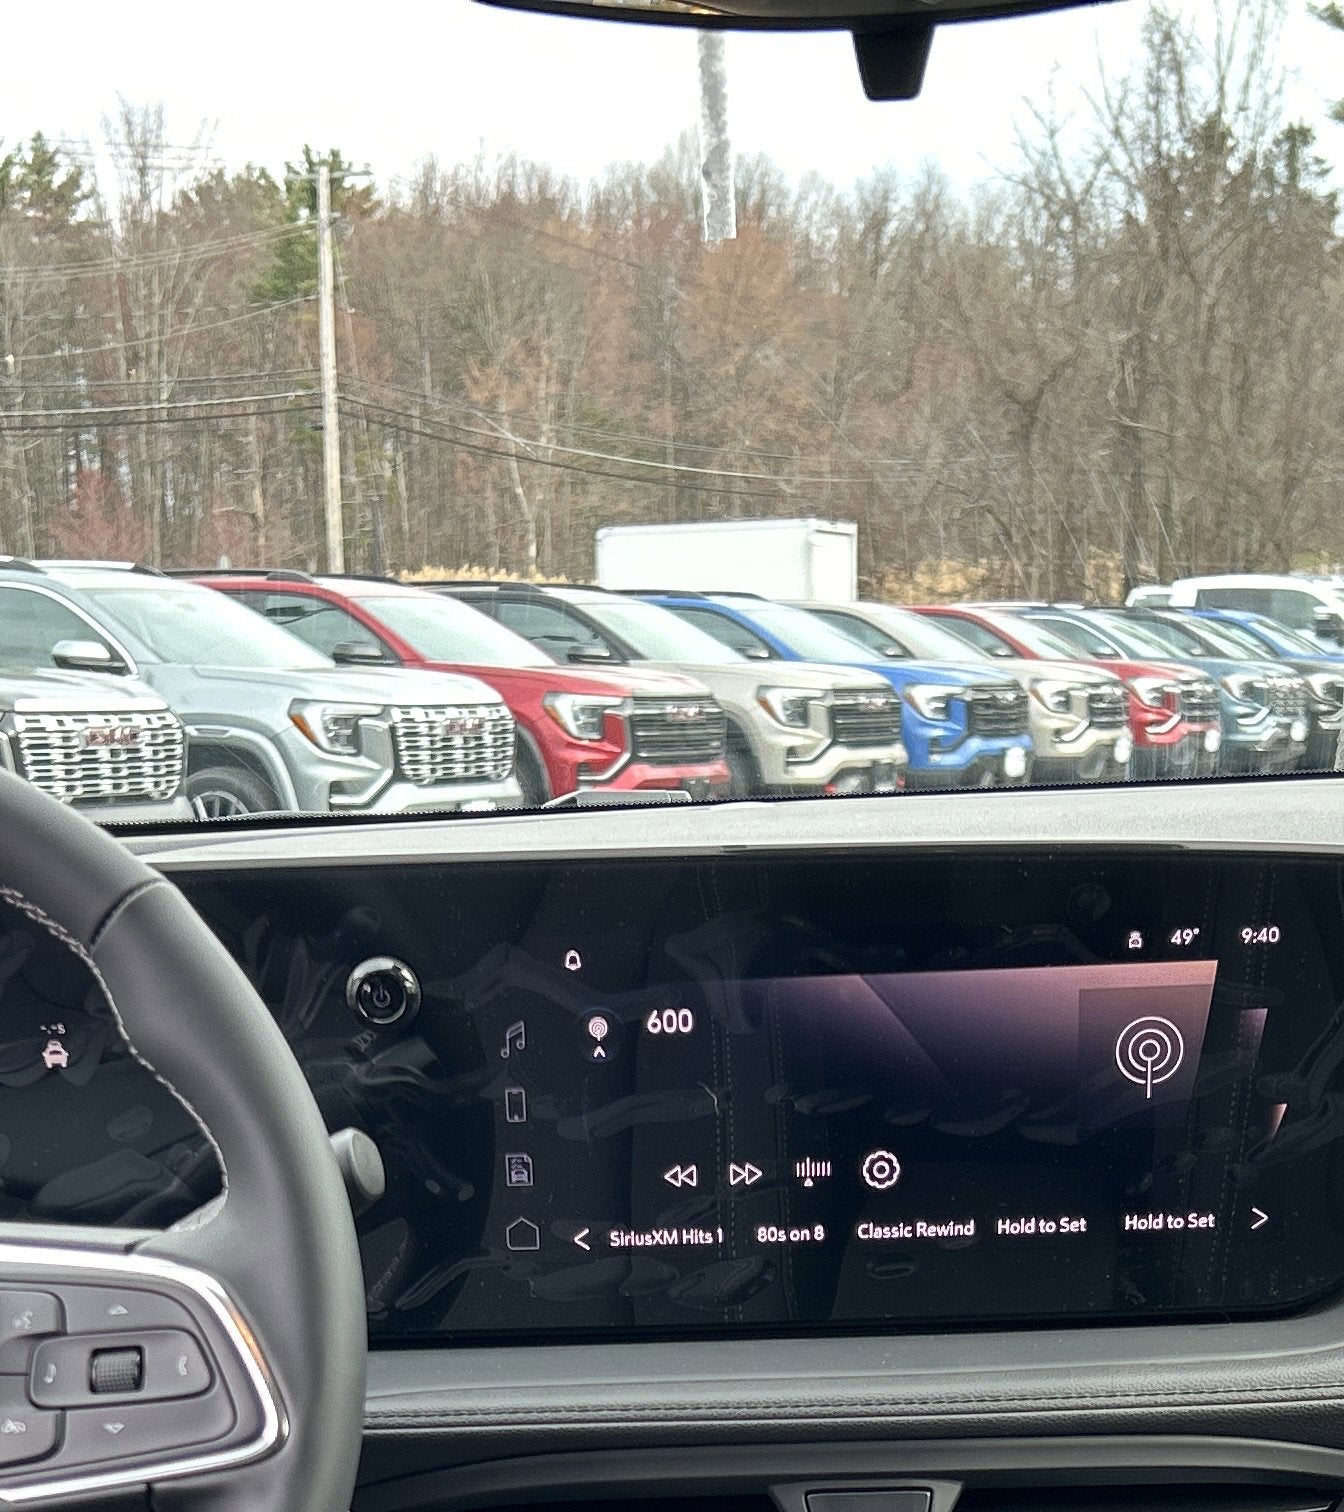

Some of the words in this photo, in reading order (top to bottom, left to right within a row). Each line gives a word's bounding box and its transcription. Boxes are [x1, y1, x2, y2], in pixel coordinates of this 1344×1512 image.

[1241, 926, 1280, 943] 9:40
[647, 1008, 693, 1033] 600
[857, 1220, 913, 1240] Classic
[916, 1219, 974, 1238] Rewind
[997, 1217, 1036, 1235] Hold
[1039, 1219, 1056, 1233] to
[1060, 1217, 1087, 1233] Set
[1124, 1212, 1163, 1231] Hold
[1167, 1214, 1184, 1229] to
[1187, 1213, 1216, 1228] Set
[609, 1229, 678, 1247] SiriusXM
[682, 1228, 713, 1245] Hits
[717, 1228, 723, 1244] 1
[757, 1226, 787, 1243] 80s
[789, 1228, 810, 1242] on
[814, 1225, 825, 1241] 8
